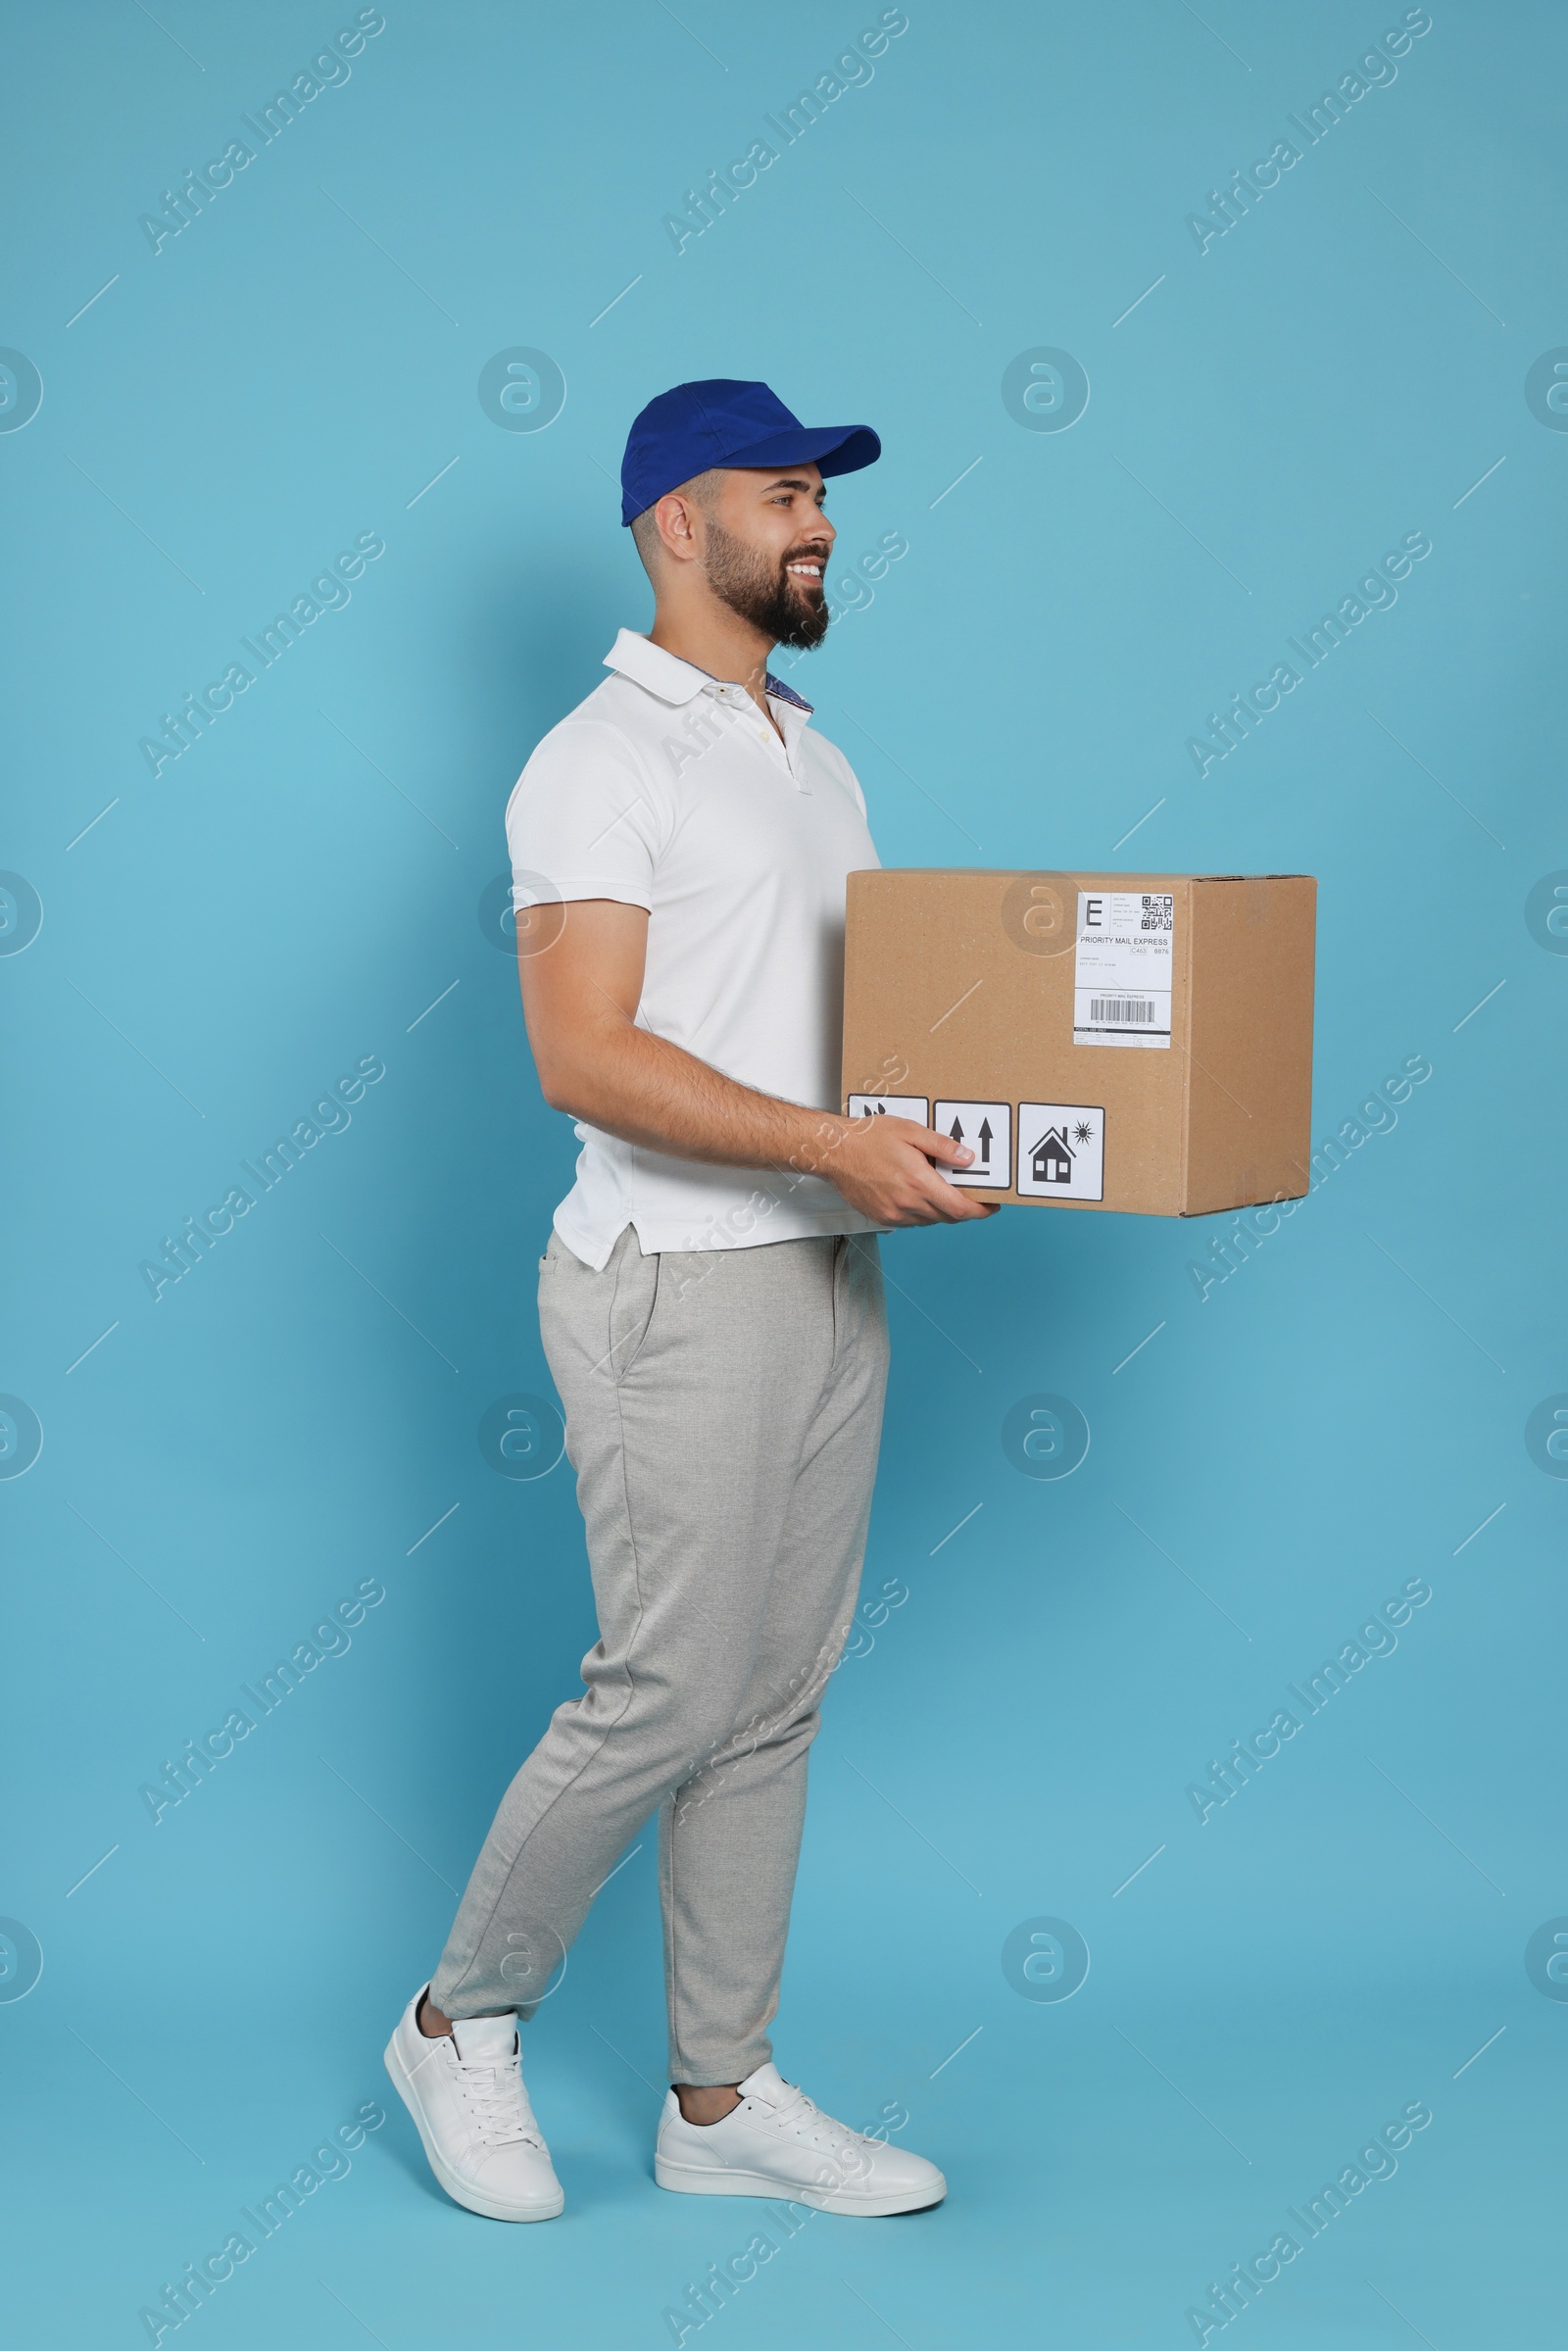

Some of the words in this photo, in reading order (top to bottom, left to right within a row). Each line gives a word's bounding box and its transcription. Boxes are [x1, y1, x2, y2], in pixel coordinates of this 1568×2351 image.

[1086, 900, 1102, 926] E
[1080, 936, 1113, 945] PRIORITY
[1133, 938, 1168, 947] EXPRESS
